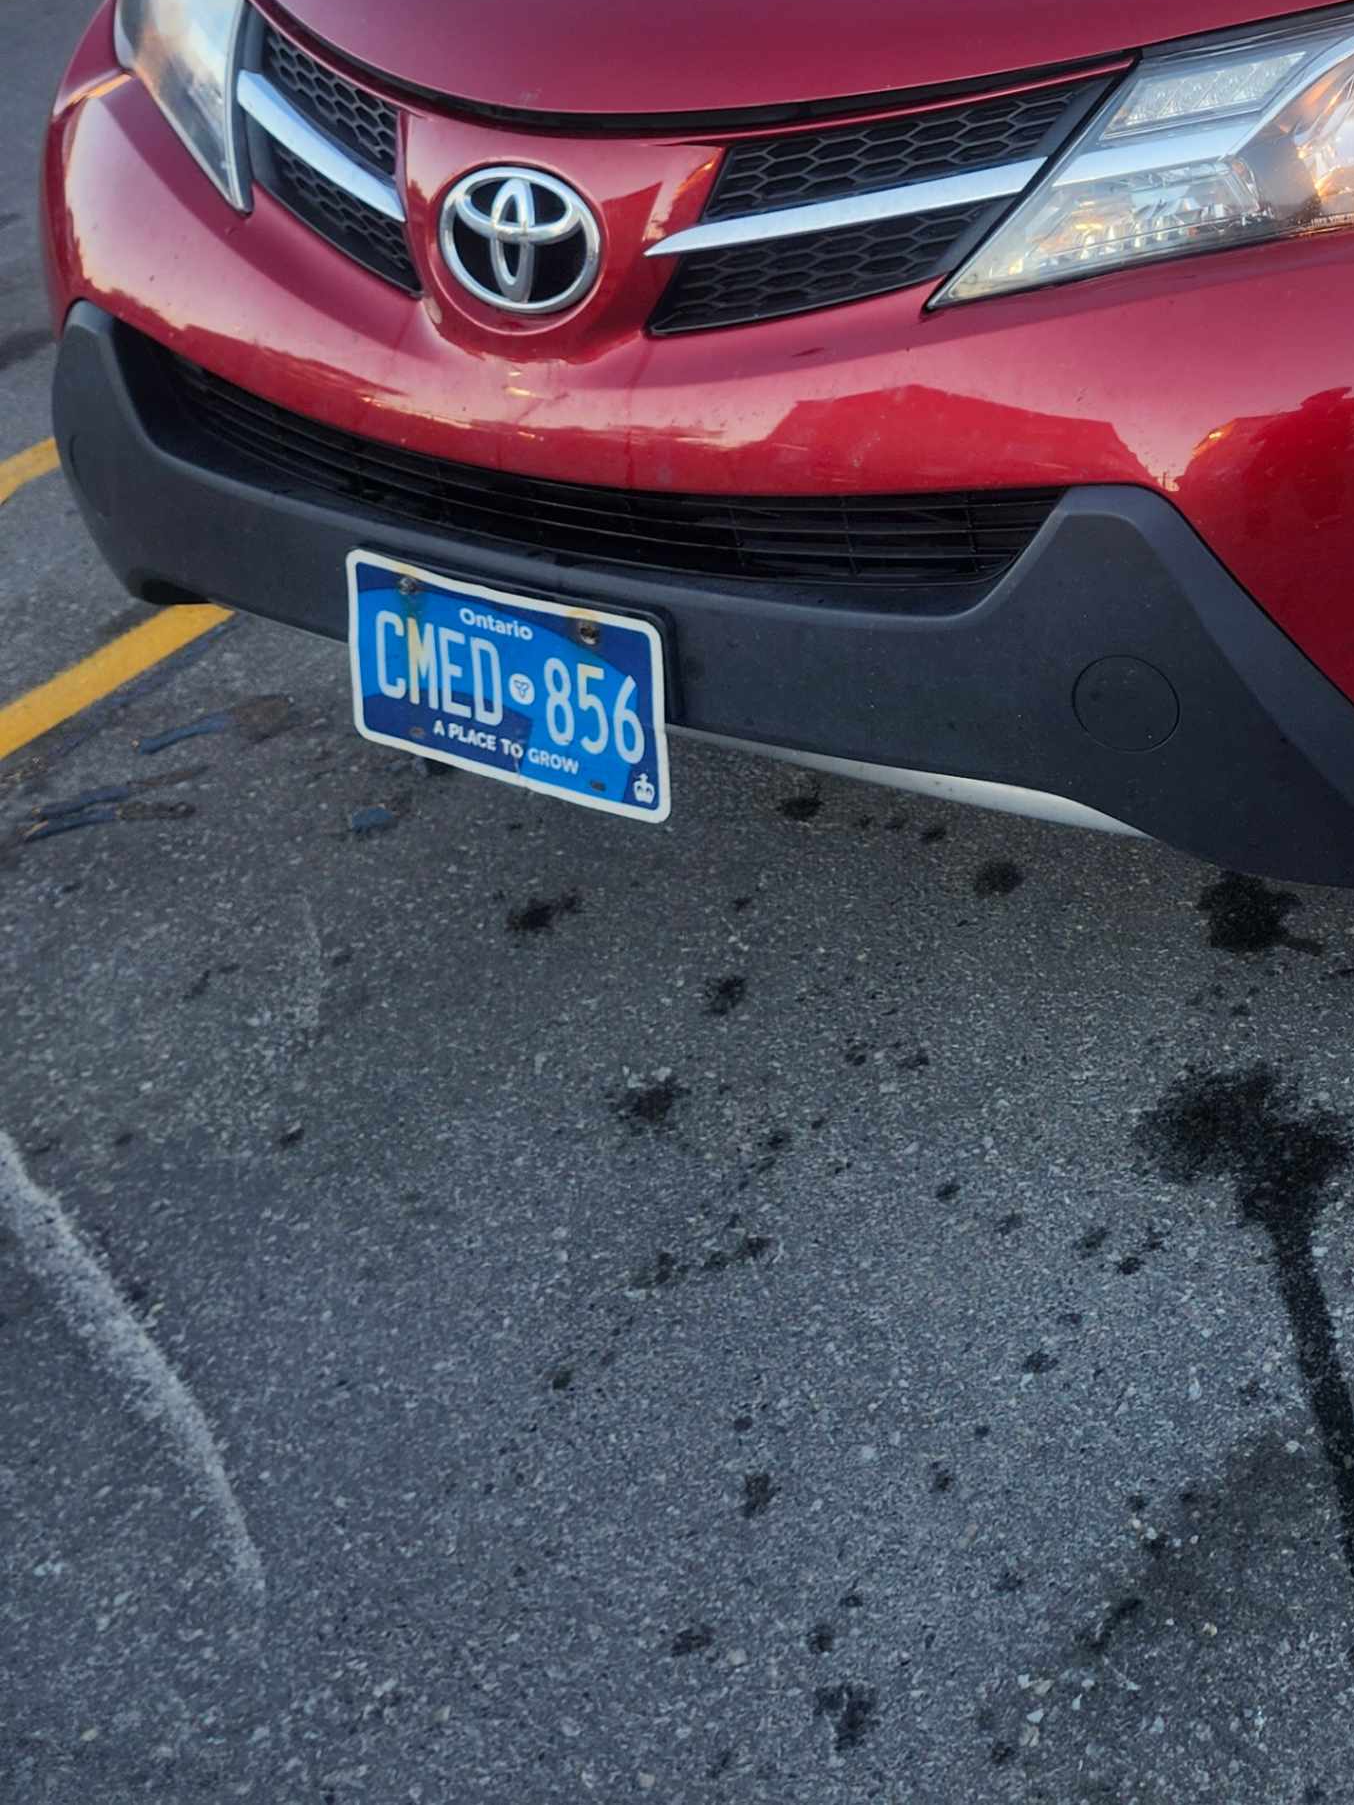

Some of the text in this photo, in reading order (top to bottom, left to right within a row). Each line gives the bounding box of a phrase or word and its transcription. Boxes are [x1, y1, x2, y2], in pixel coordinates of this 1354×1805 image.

[459, 607, 534, 641] Ontario
[376, 610, 645, 764] CMED 856
[433, 719, 579, 775] A PLACE TO GROW
